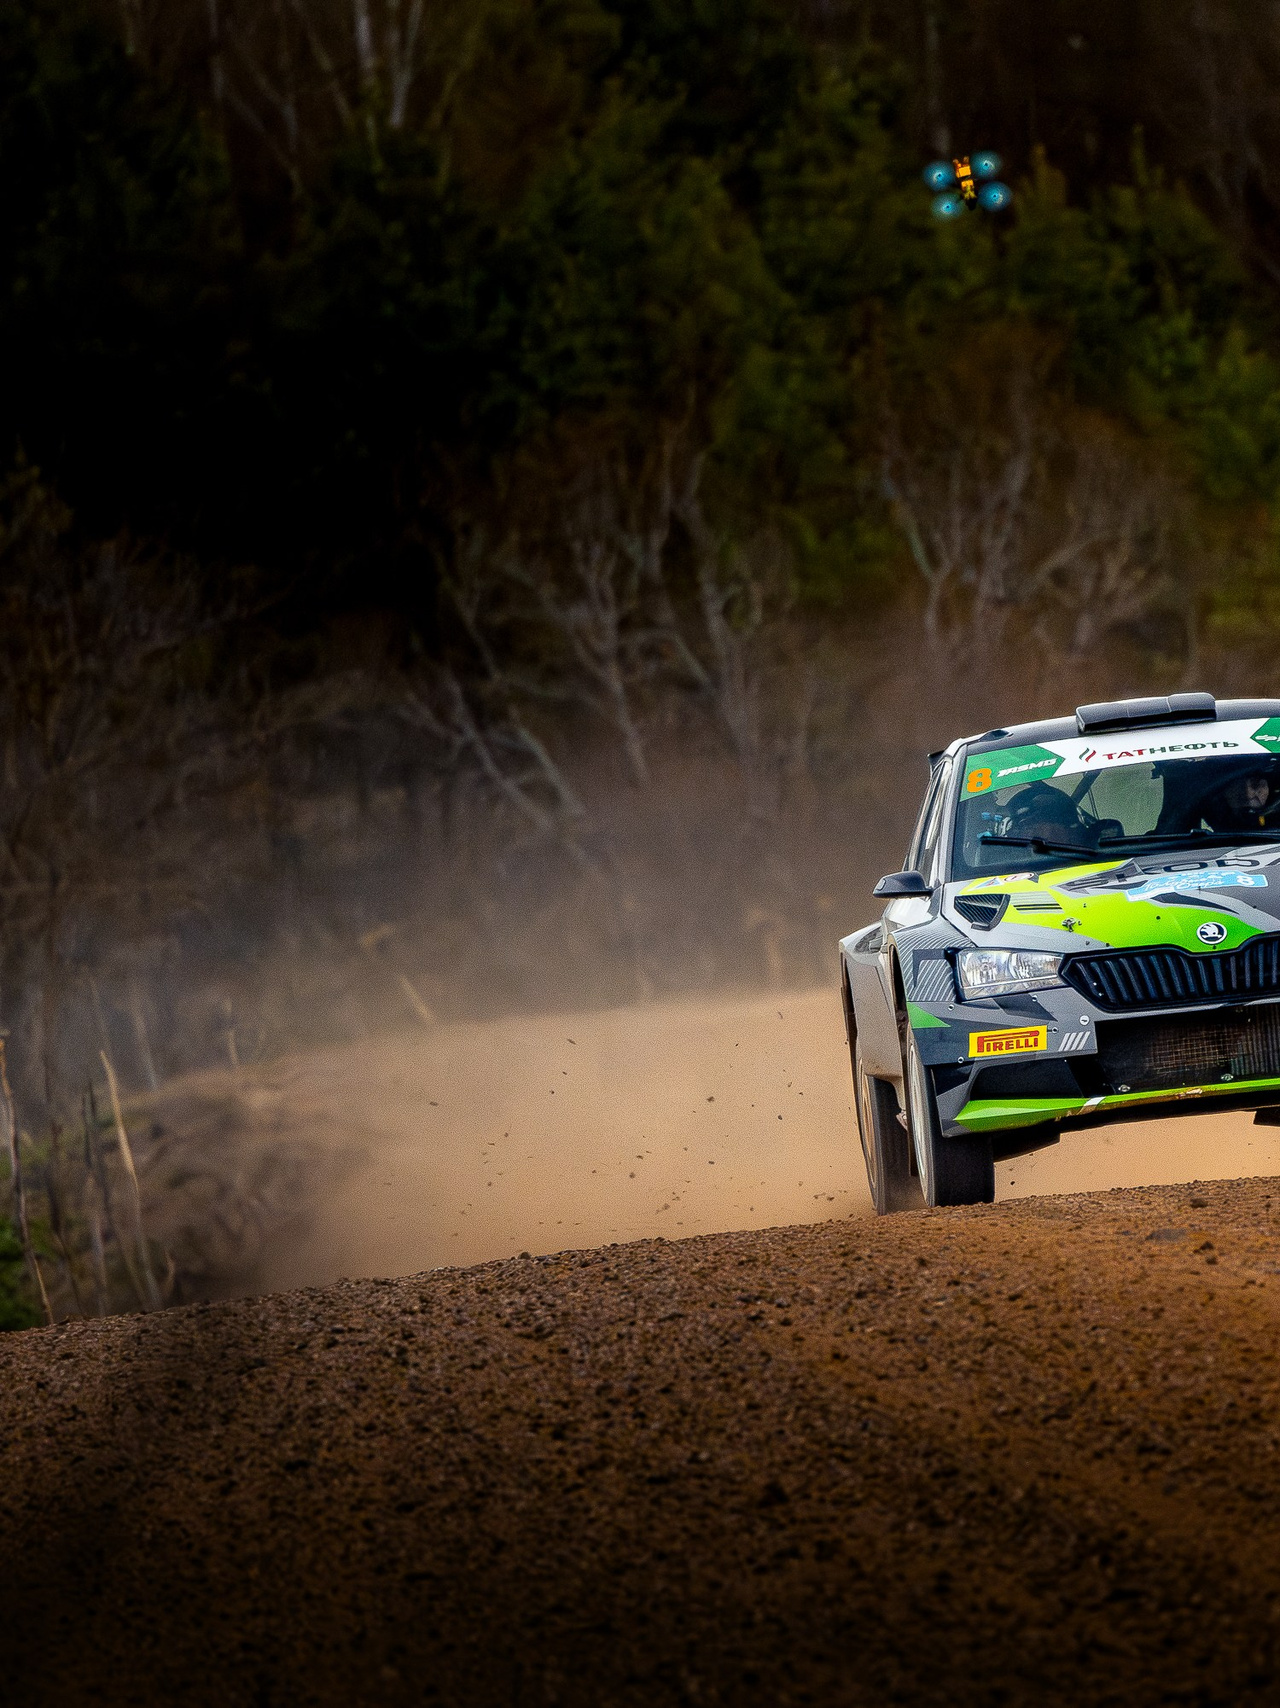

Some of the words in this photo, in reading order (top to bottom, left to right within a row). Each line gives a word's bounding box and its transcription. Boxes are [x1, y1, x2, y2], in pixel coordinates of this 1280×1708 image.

[1101, 741, 1240, 761] ТАТНЕФТЬ
[966, 767, 993, 793] 8
[1236, 875, 1255, 886] 8
[976, 1030, 1040, 1053] PIRELLI
